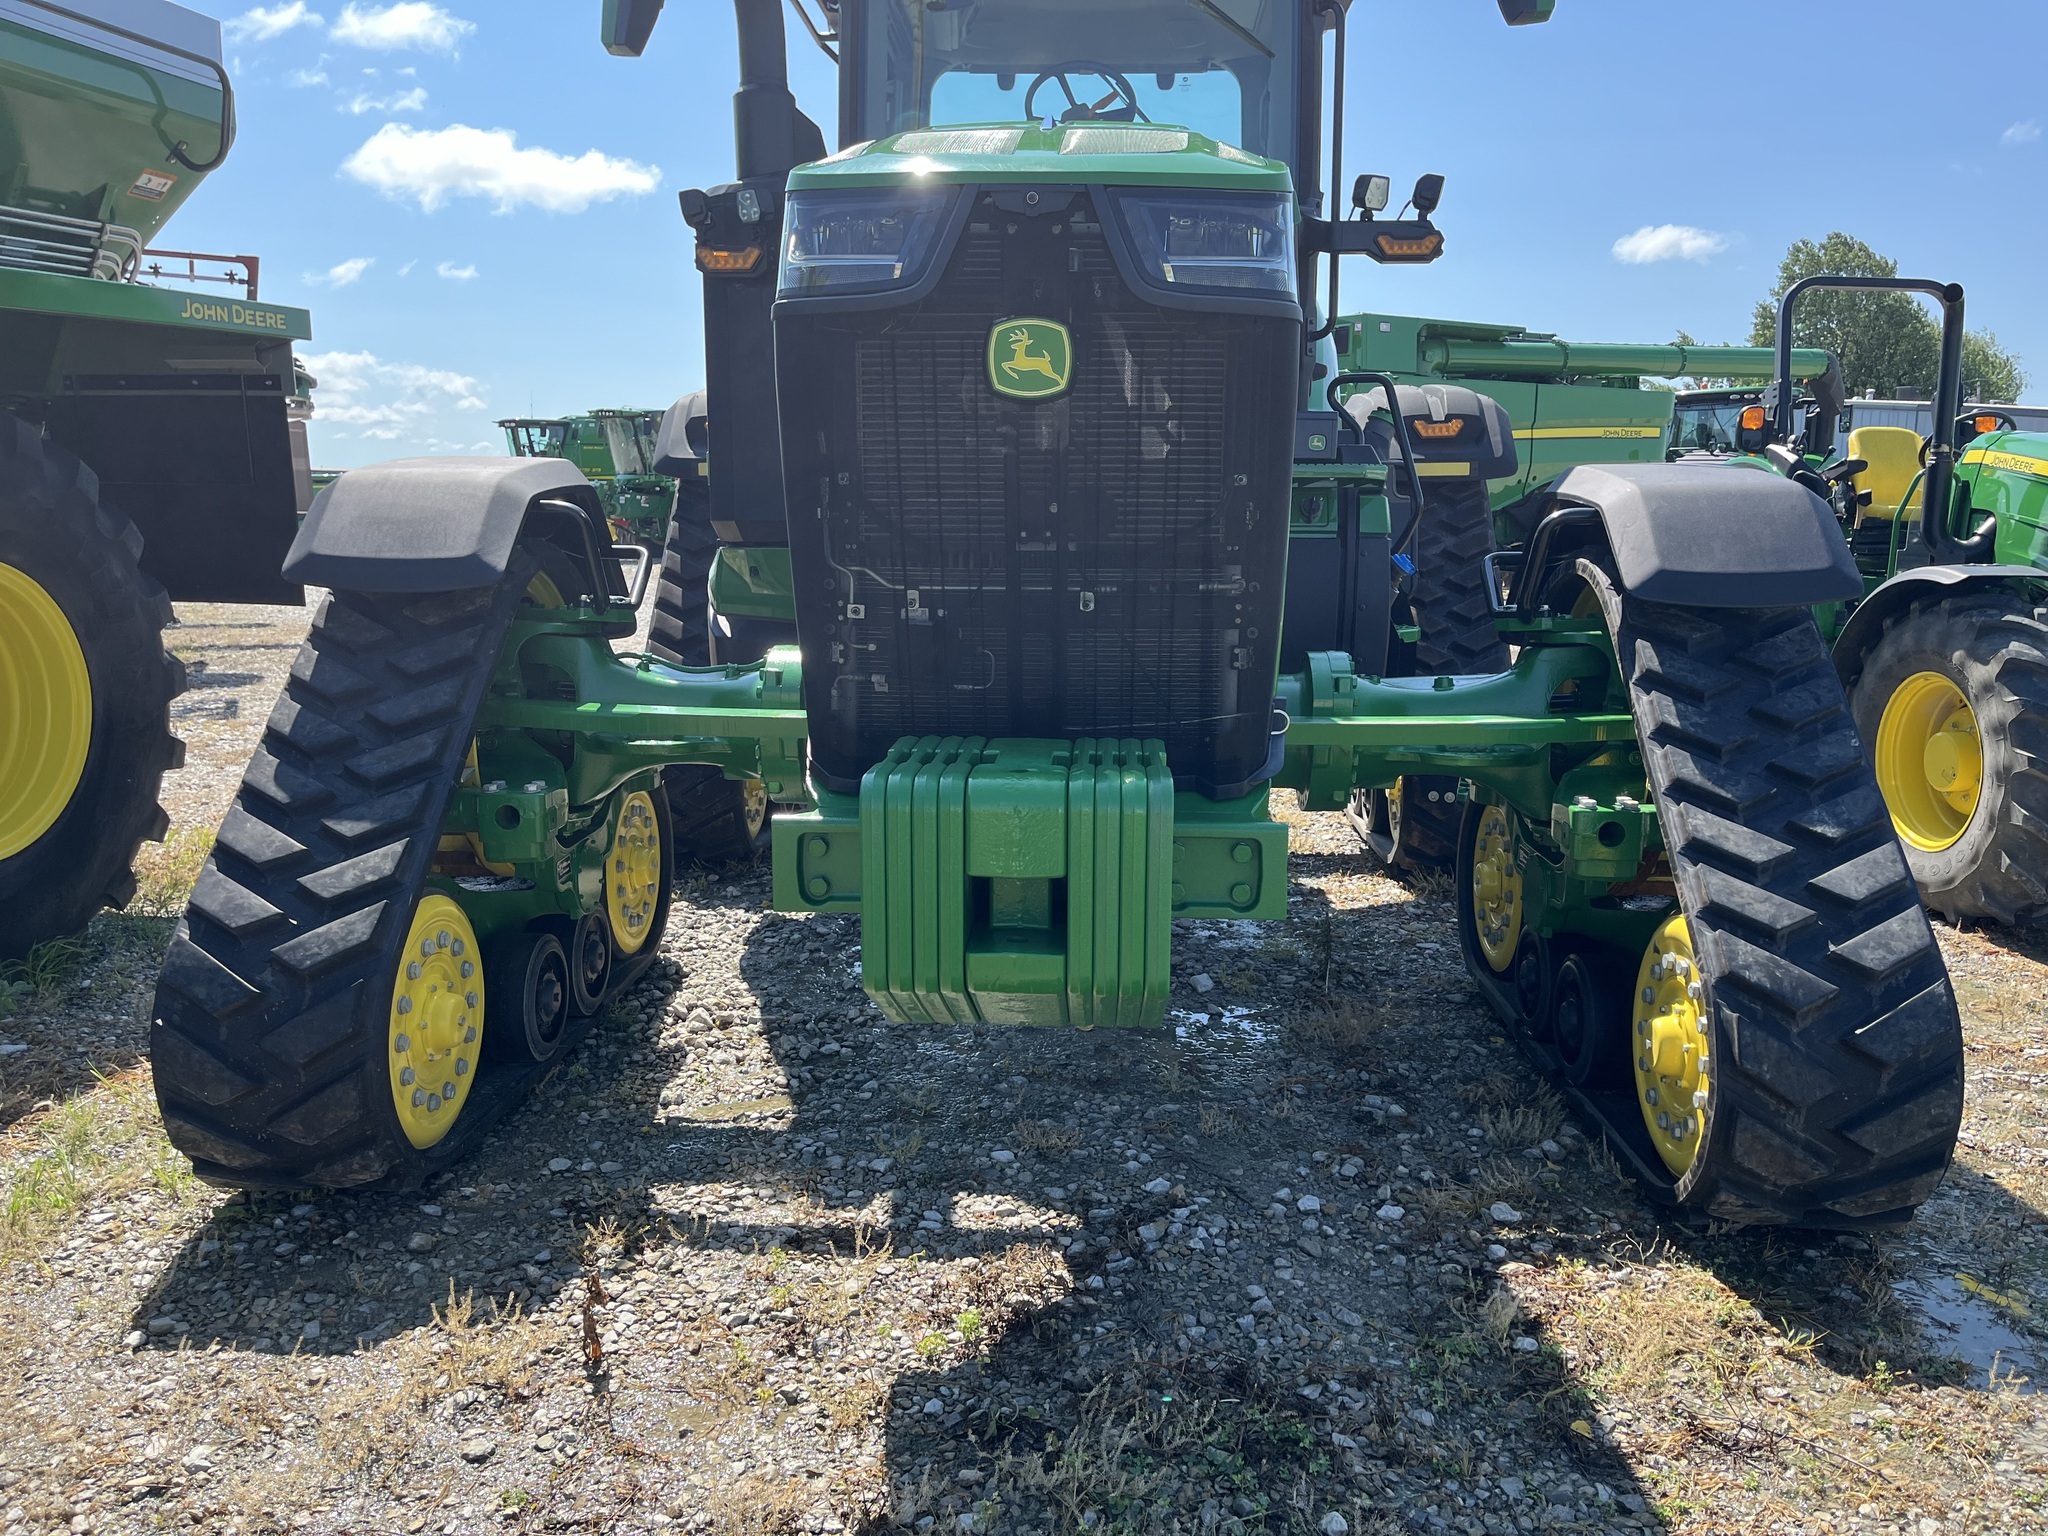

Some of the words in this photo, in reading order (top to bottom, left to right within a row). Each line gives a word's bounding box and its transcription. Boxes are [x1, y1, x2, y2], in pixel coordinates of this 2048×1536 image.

[181, 298, 229, 322] JOHN
[232, 304, 287, 330] DEERE
[1602, 429, 1620, 437] JOHN
[1620, 429, 1643, 437] DEERE
[1989, 454, 2009, 469] JOHN
[2009, 457, 2035, 472] DEERE
